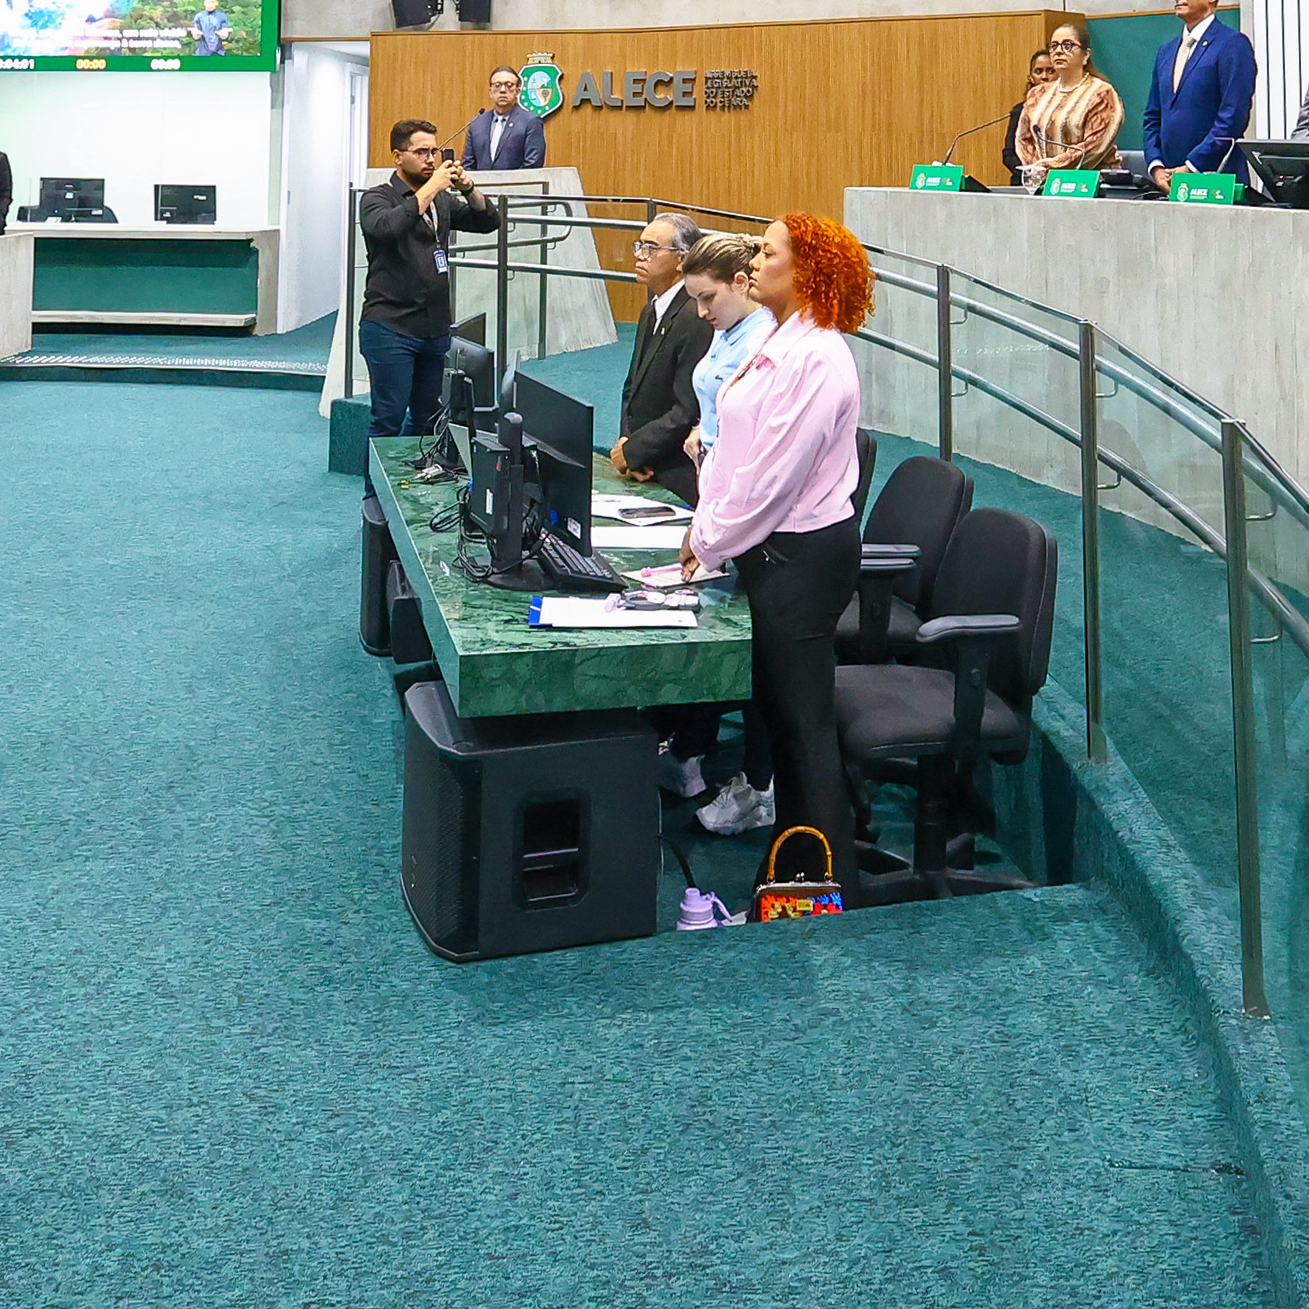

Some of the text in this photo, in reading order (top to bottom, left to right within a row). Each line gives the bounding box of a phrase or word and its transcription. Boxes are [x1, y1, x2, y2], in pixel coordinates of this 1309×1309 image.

[76, 58, 107, 70] 00:00
[571, 70, 697, 109] ALECE
[718, 87, 753, 98] ESTADO
